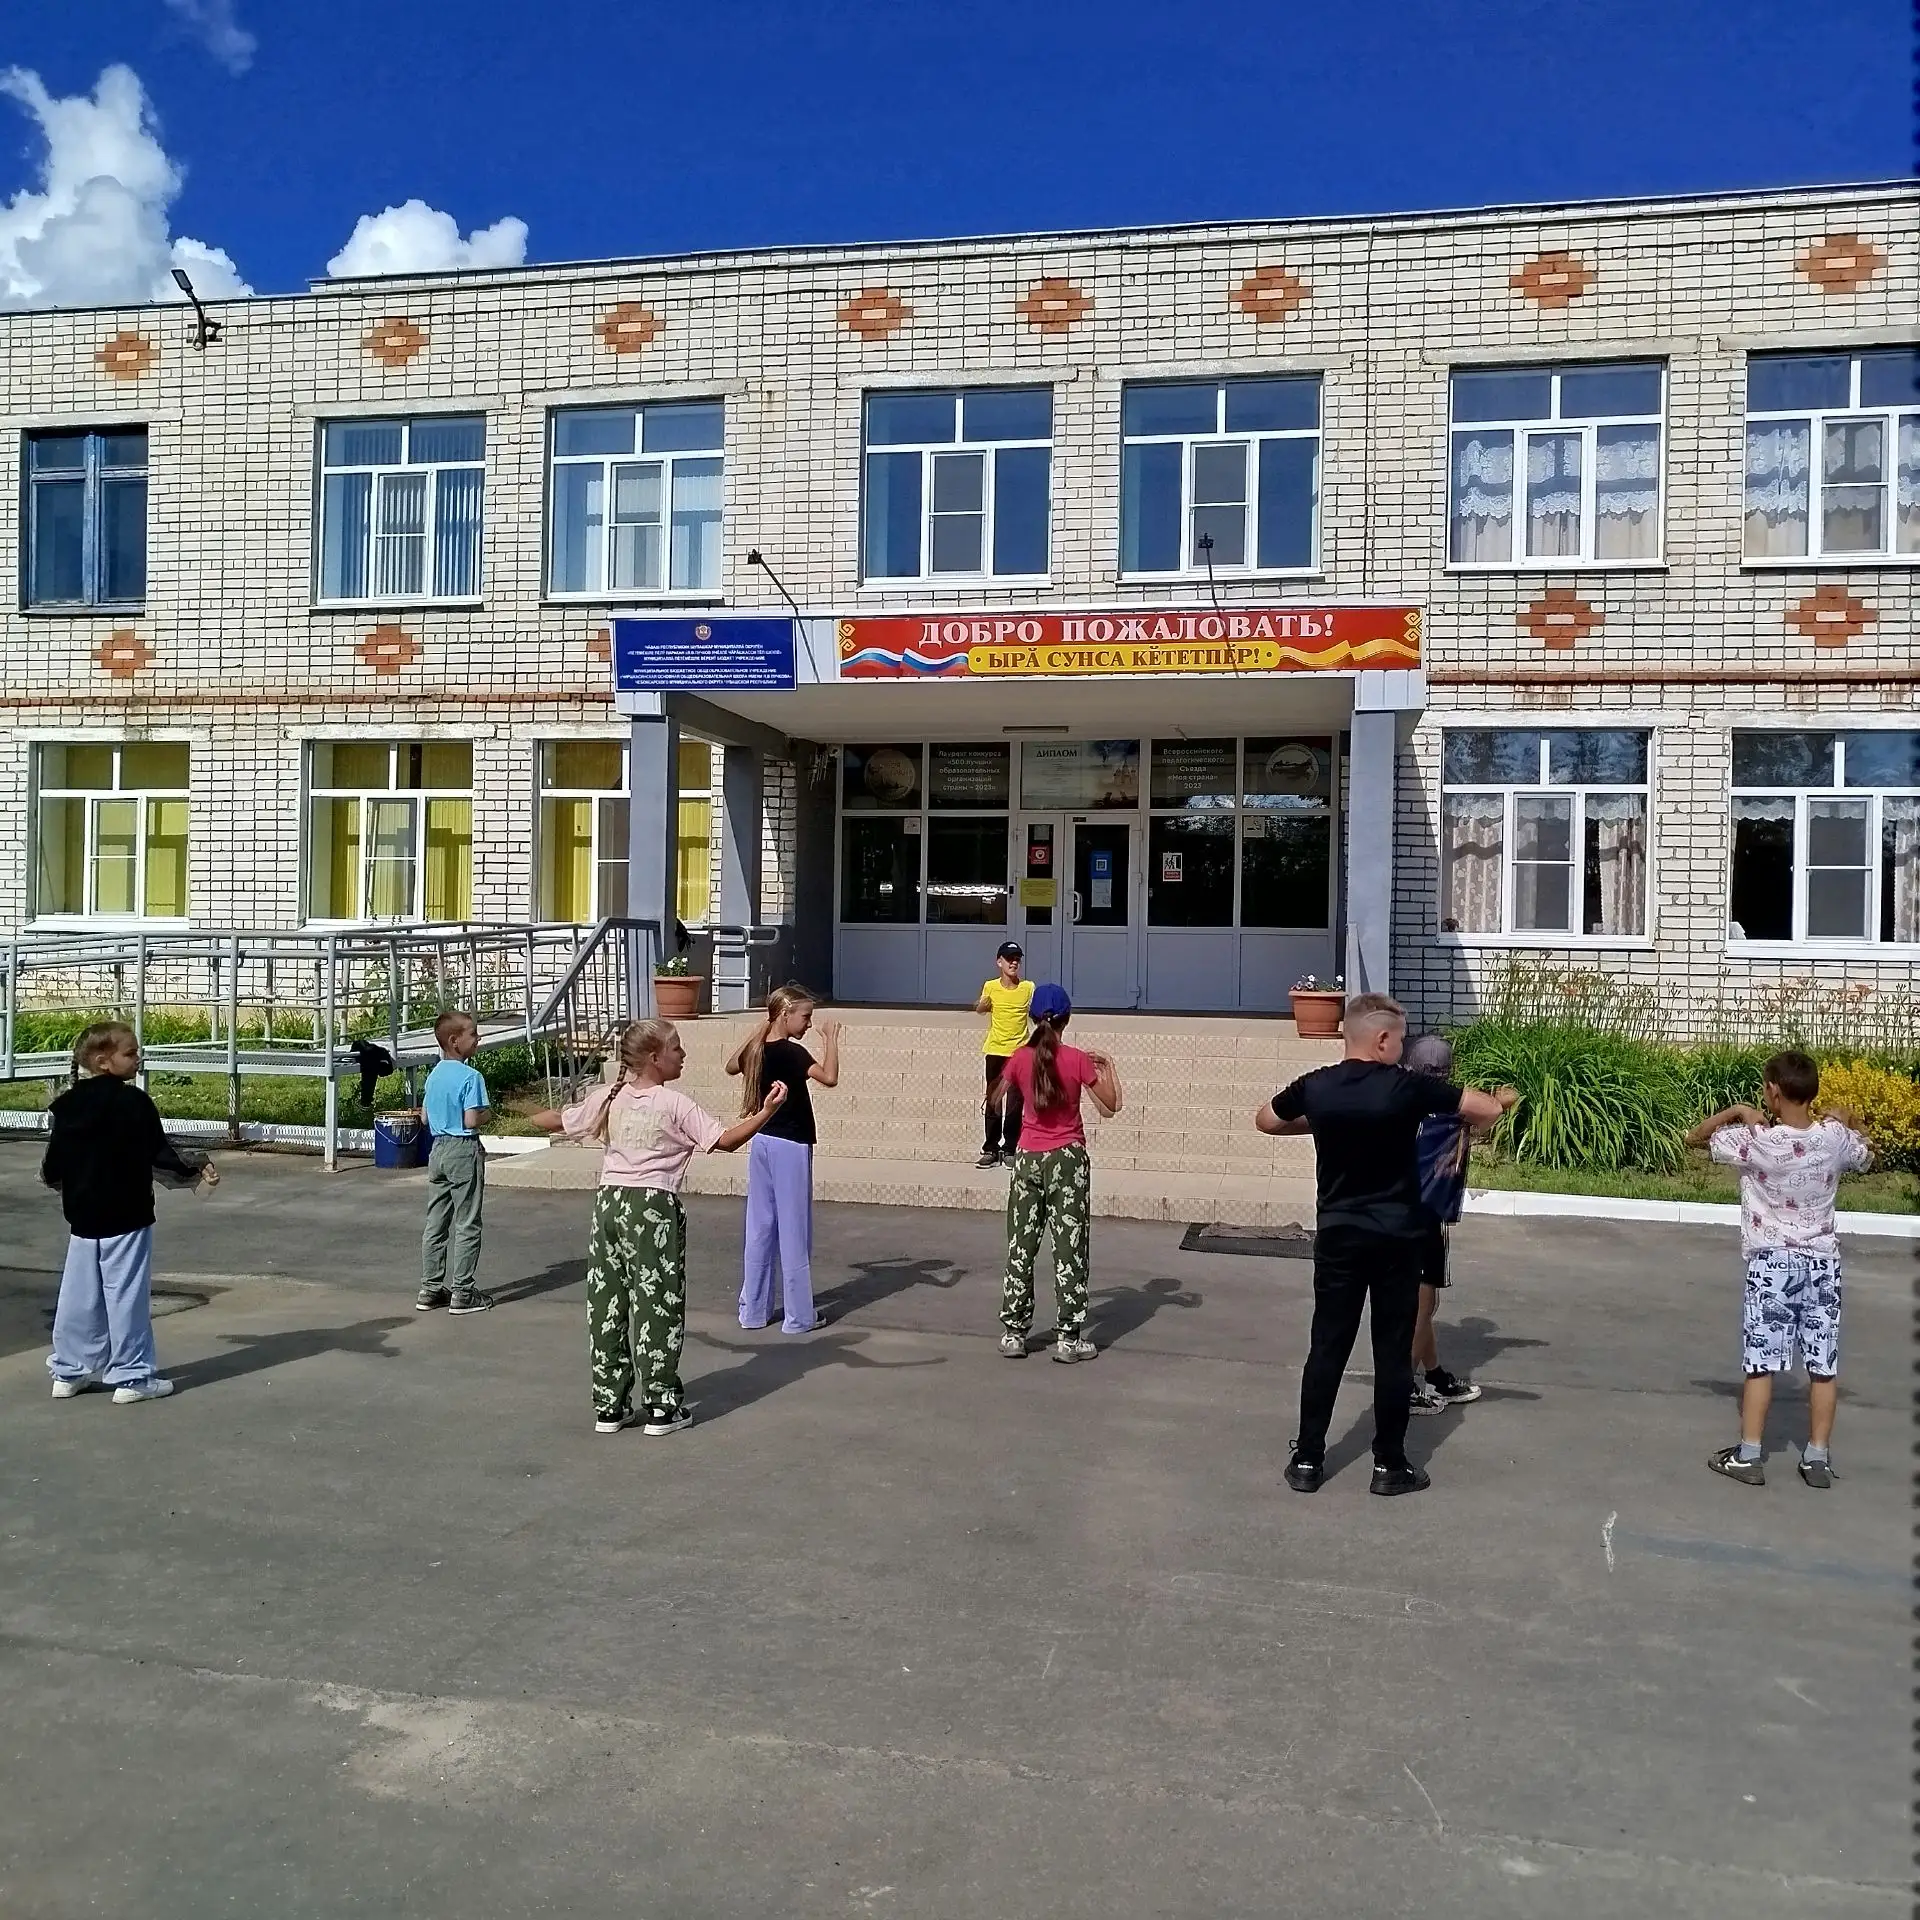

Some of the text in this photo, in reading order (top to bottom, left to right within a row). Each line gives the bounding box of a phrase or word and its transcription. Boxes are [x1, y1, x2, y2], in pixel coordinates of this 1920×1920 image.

[918, 614, 1334, 648] ДОБРО ПОЖАЛОВАТЬ!
[1047, 651, 1125, 668] СУНСА
[1036, 749, 1077, 758] ДИПЛОМ
[1179, 765, 1207, 773] Съезда
